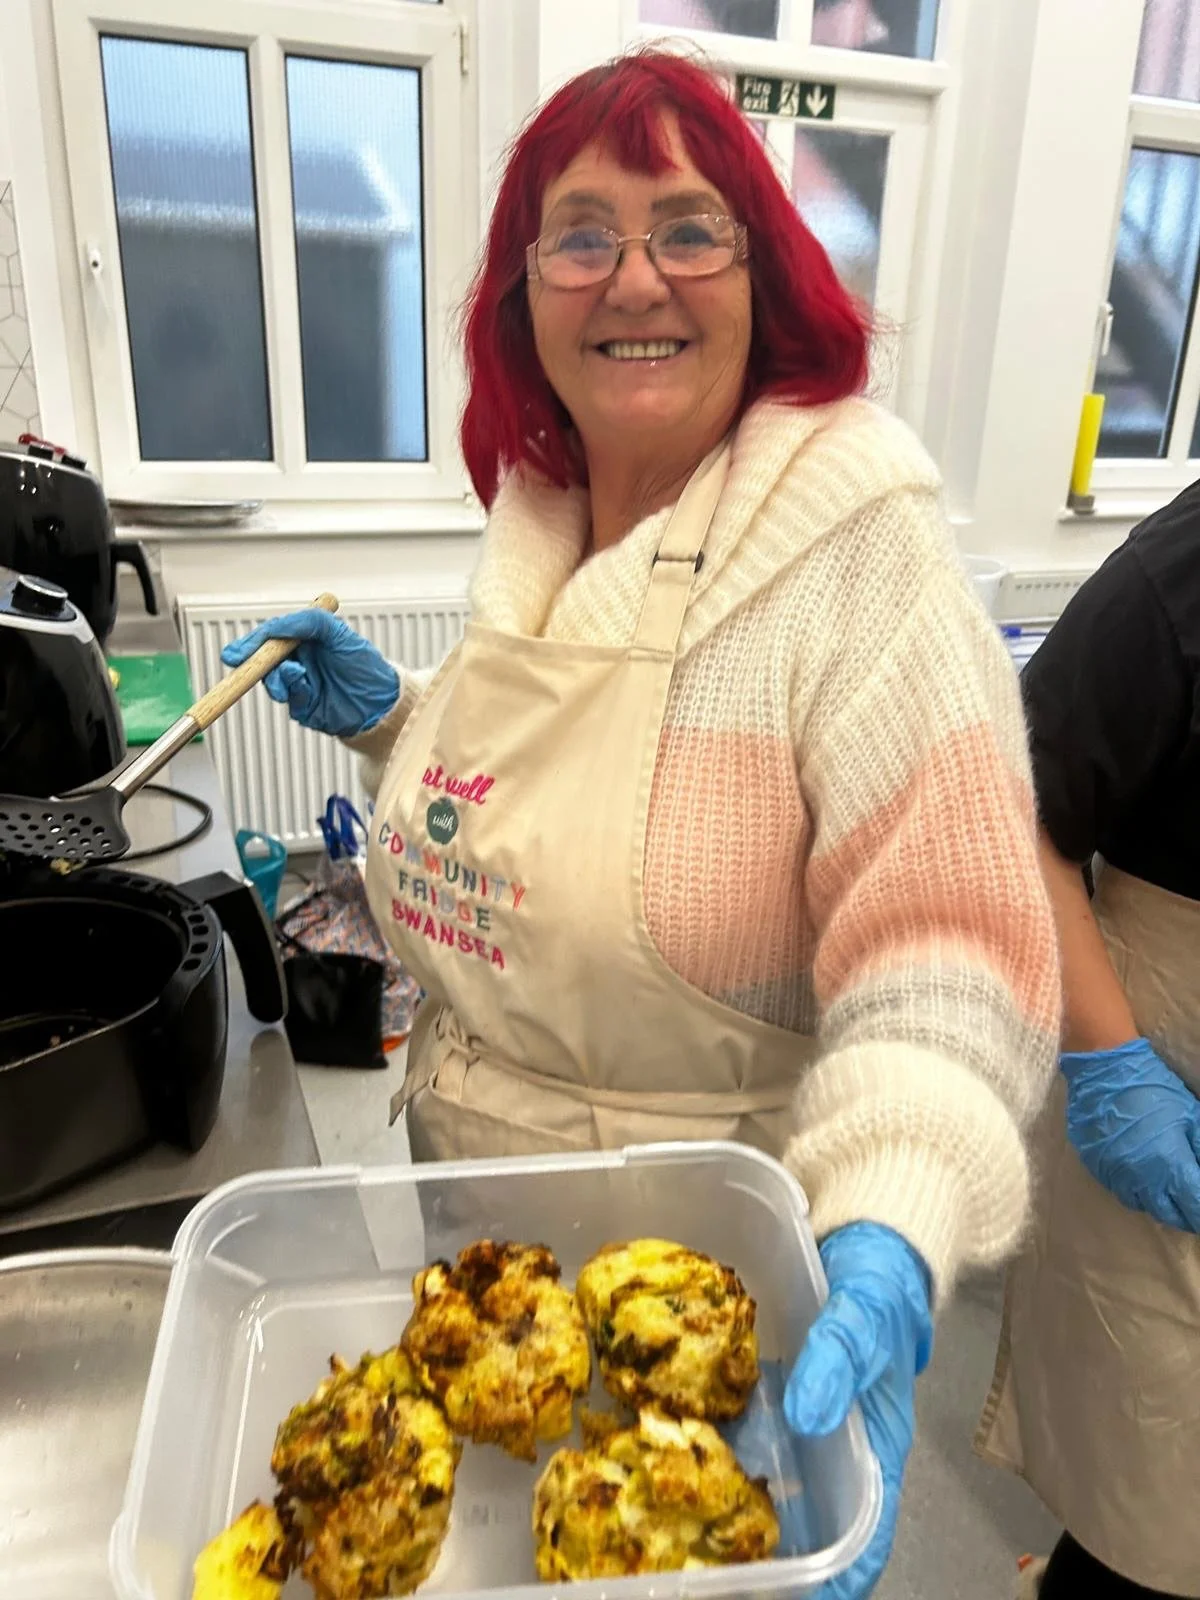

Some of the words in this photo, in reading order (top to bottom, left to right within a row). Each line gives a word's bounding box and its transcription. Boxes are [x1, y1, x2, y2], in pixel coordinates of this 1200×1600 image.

[743, 77, 771, 94] Fire
[743, 94, 769, 111] exit
[446, 774, 495, 805] well
[432, 815, 453, 832] with
[391, 898, 505, 970] SWANSEA
